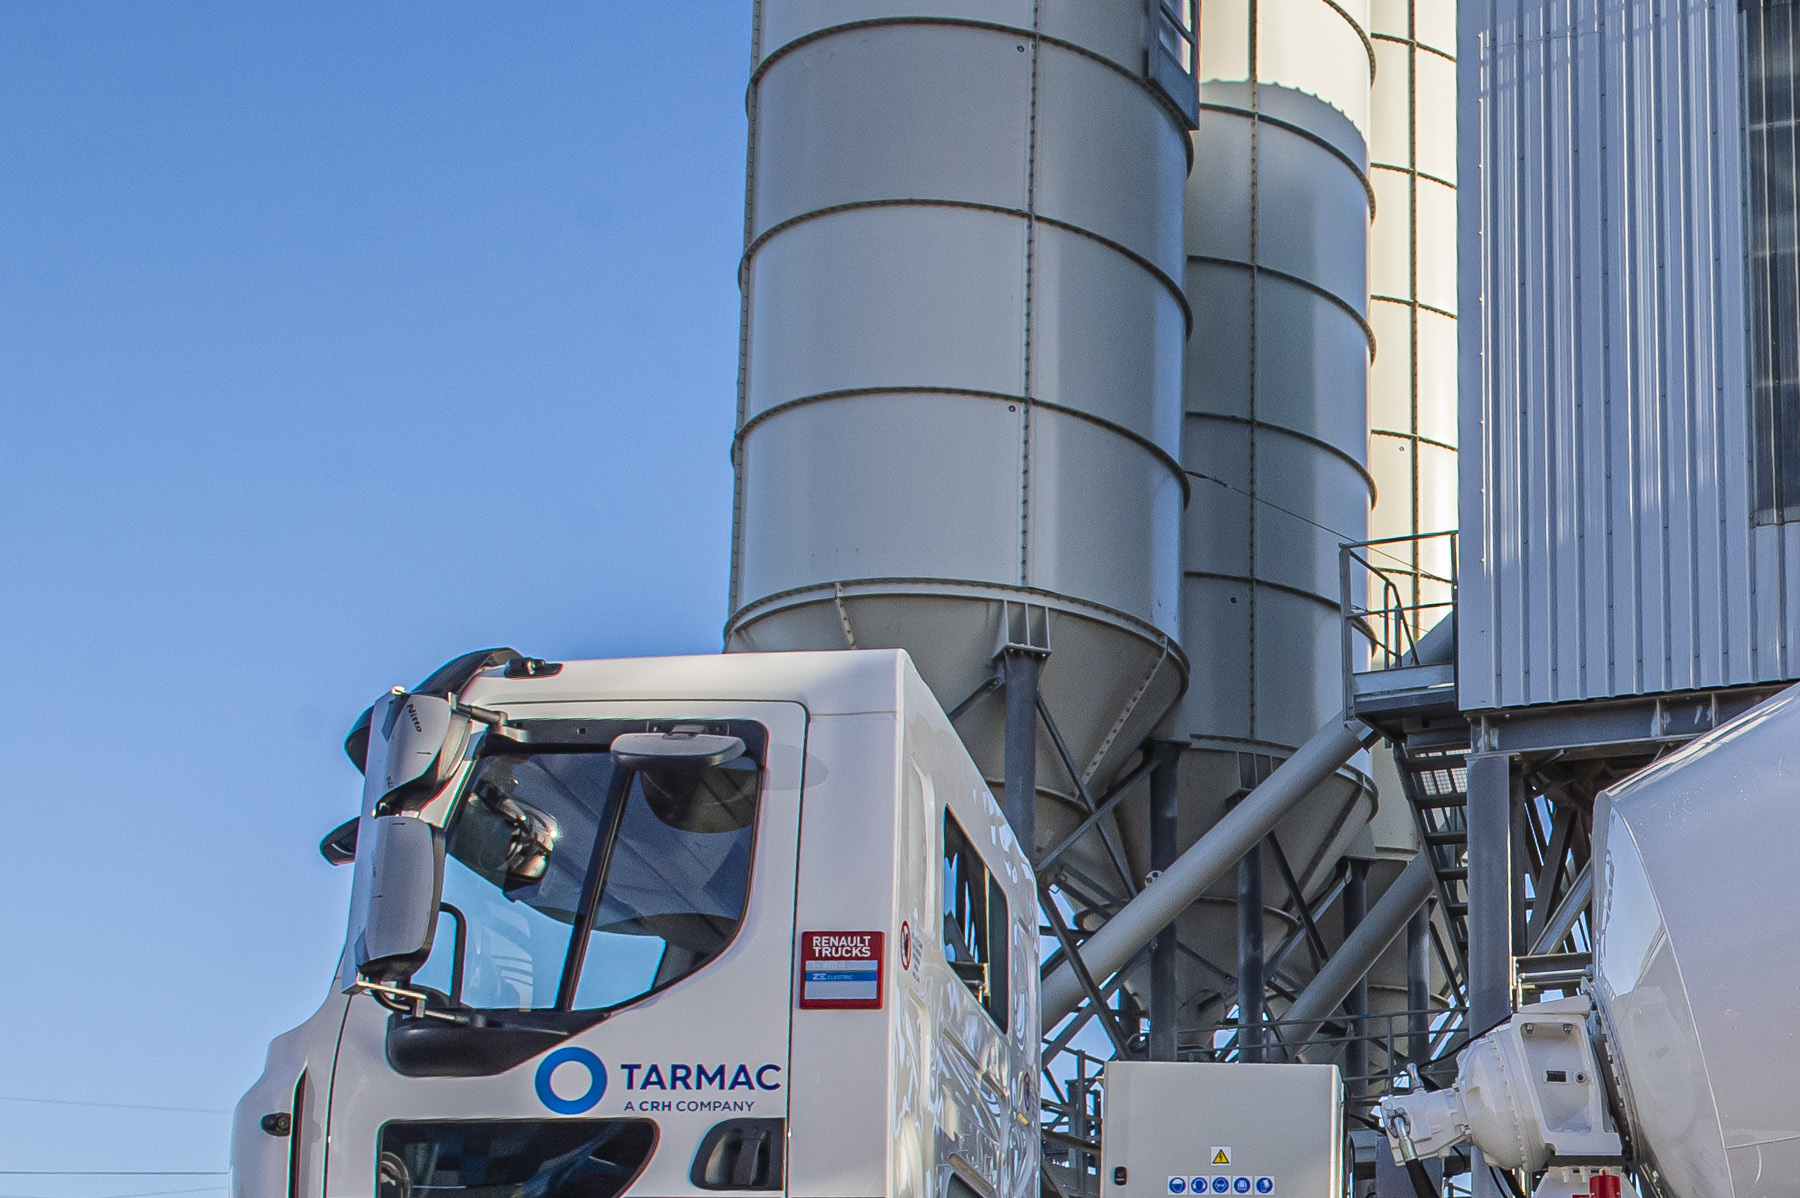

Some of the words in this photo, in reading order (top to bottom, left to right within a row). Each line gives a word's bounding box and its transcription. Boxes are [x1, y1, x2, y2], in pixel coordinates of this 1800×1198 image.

[406, 703, 422, 733] Nitto
[812, 935, 871, 948] RENAULT
[813, 946, 871, 958] TRUCKS
[620, 1063, 782, 1091] TARMAC
[624, 1101, 634, 1112] A
[639, 1101, 672, 1112] CRH
[676, 1100, 755, 1112] COMPANY
